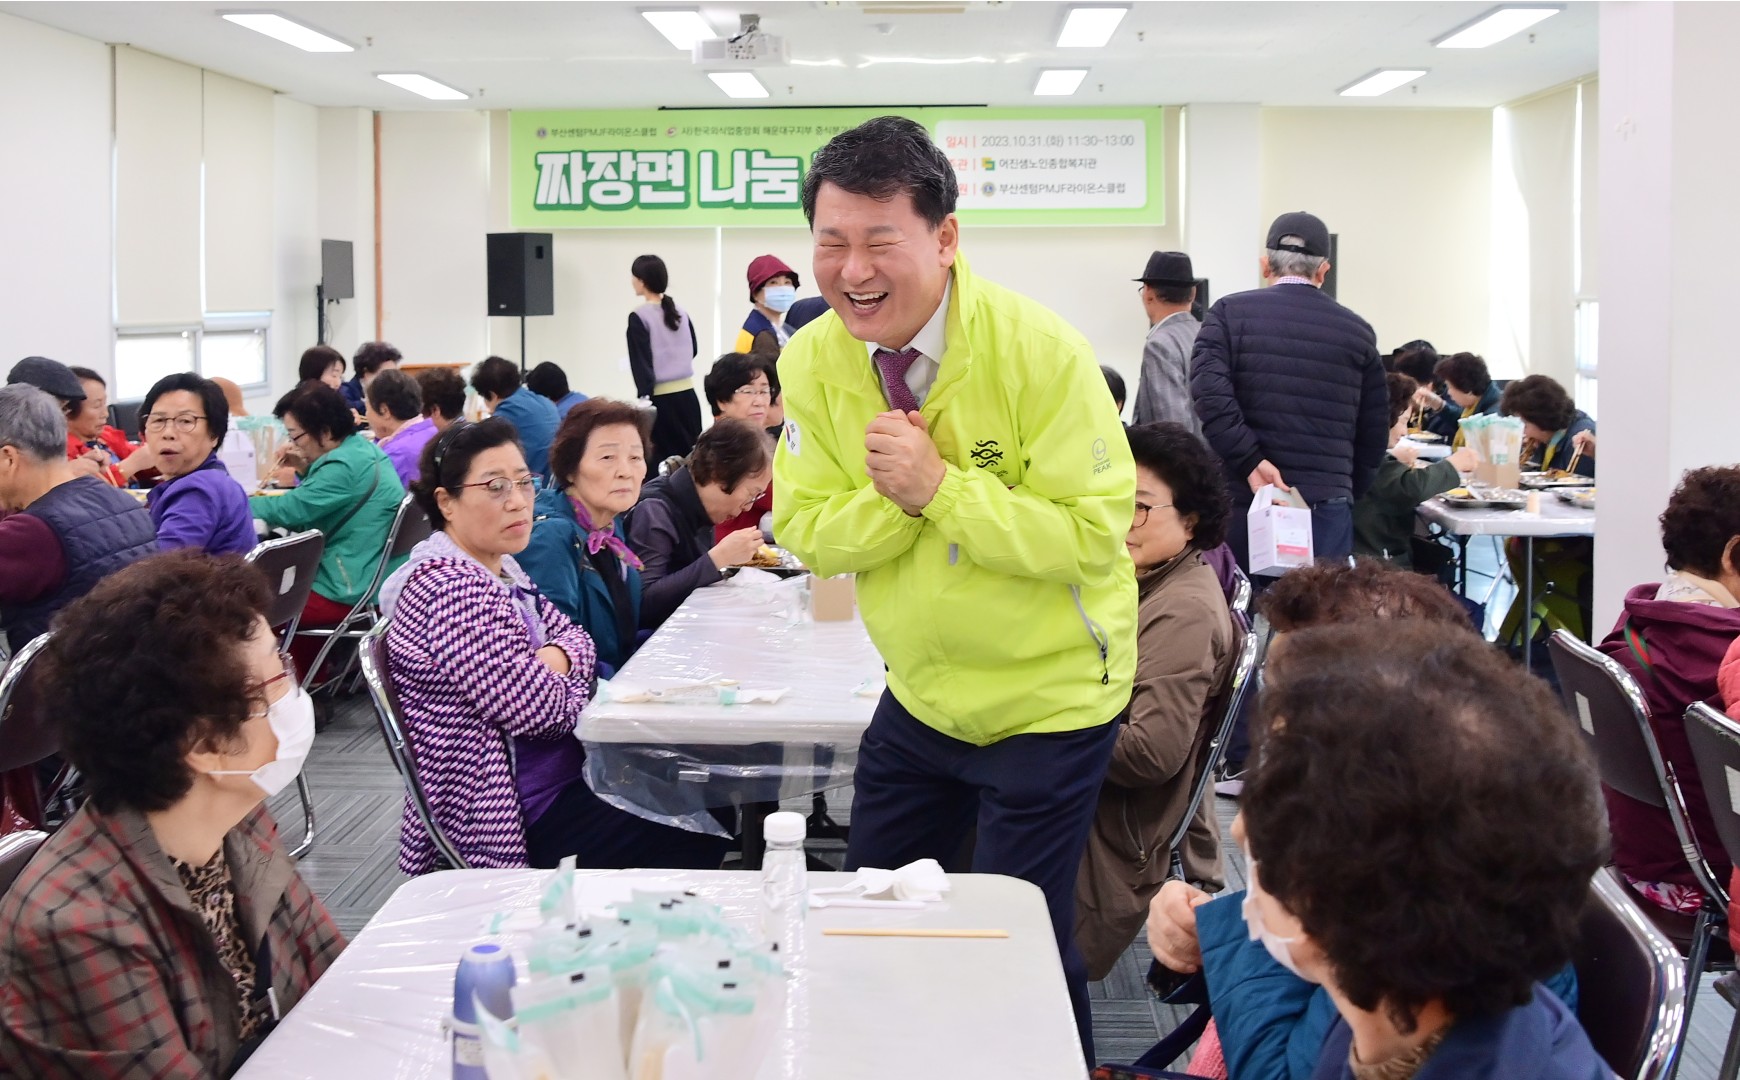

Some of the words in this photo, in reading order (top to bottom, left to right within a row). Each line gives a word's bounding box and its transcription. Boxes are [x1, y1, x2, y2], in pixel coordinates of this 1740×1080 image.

[946, 135, 968, 148] 일시
[534, 150, 690, 209] 짜장면
[698, 149, 803, 208] 나눔
[1000, 183, 1126, 195] 부산센텀PMJF라이온스클럽
[1093, 462, 1111, 475] PEAK
